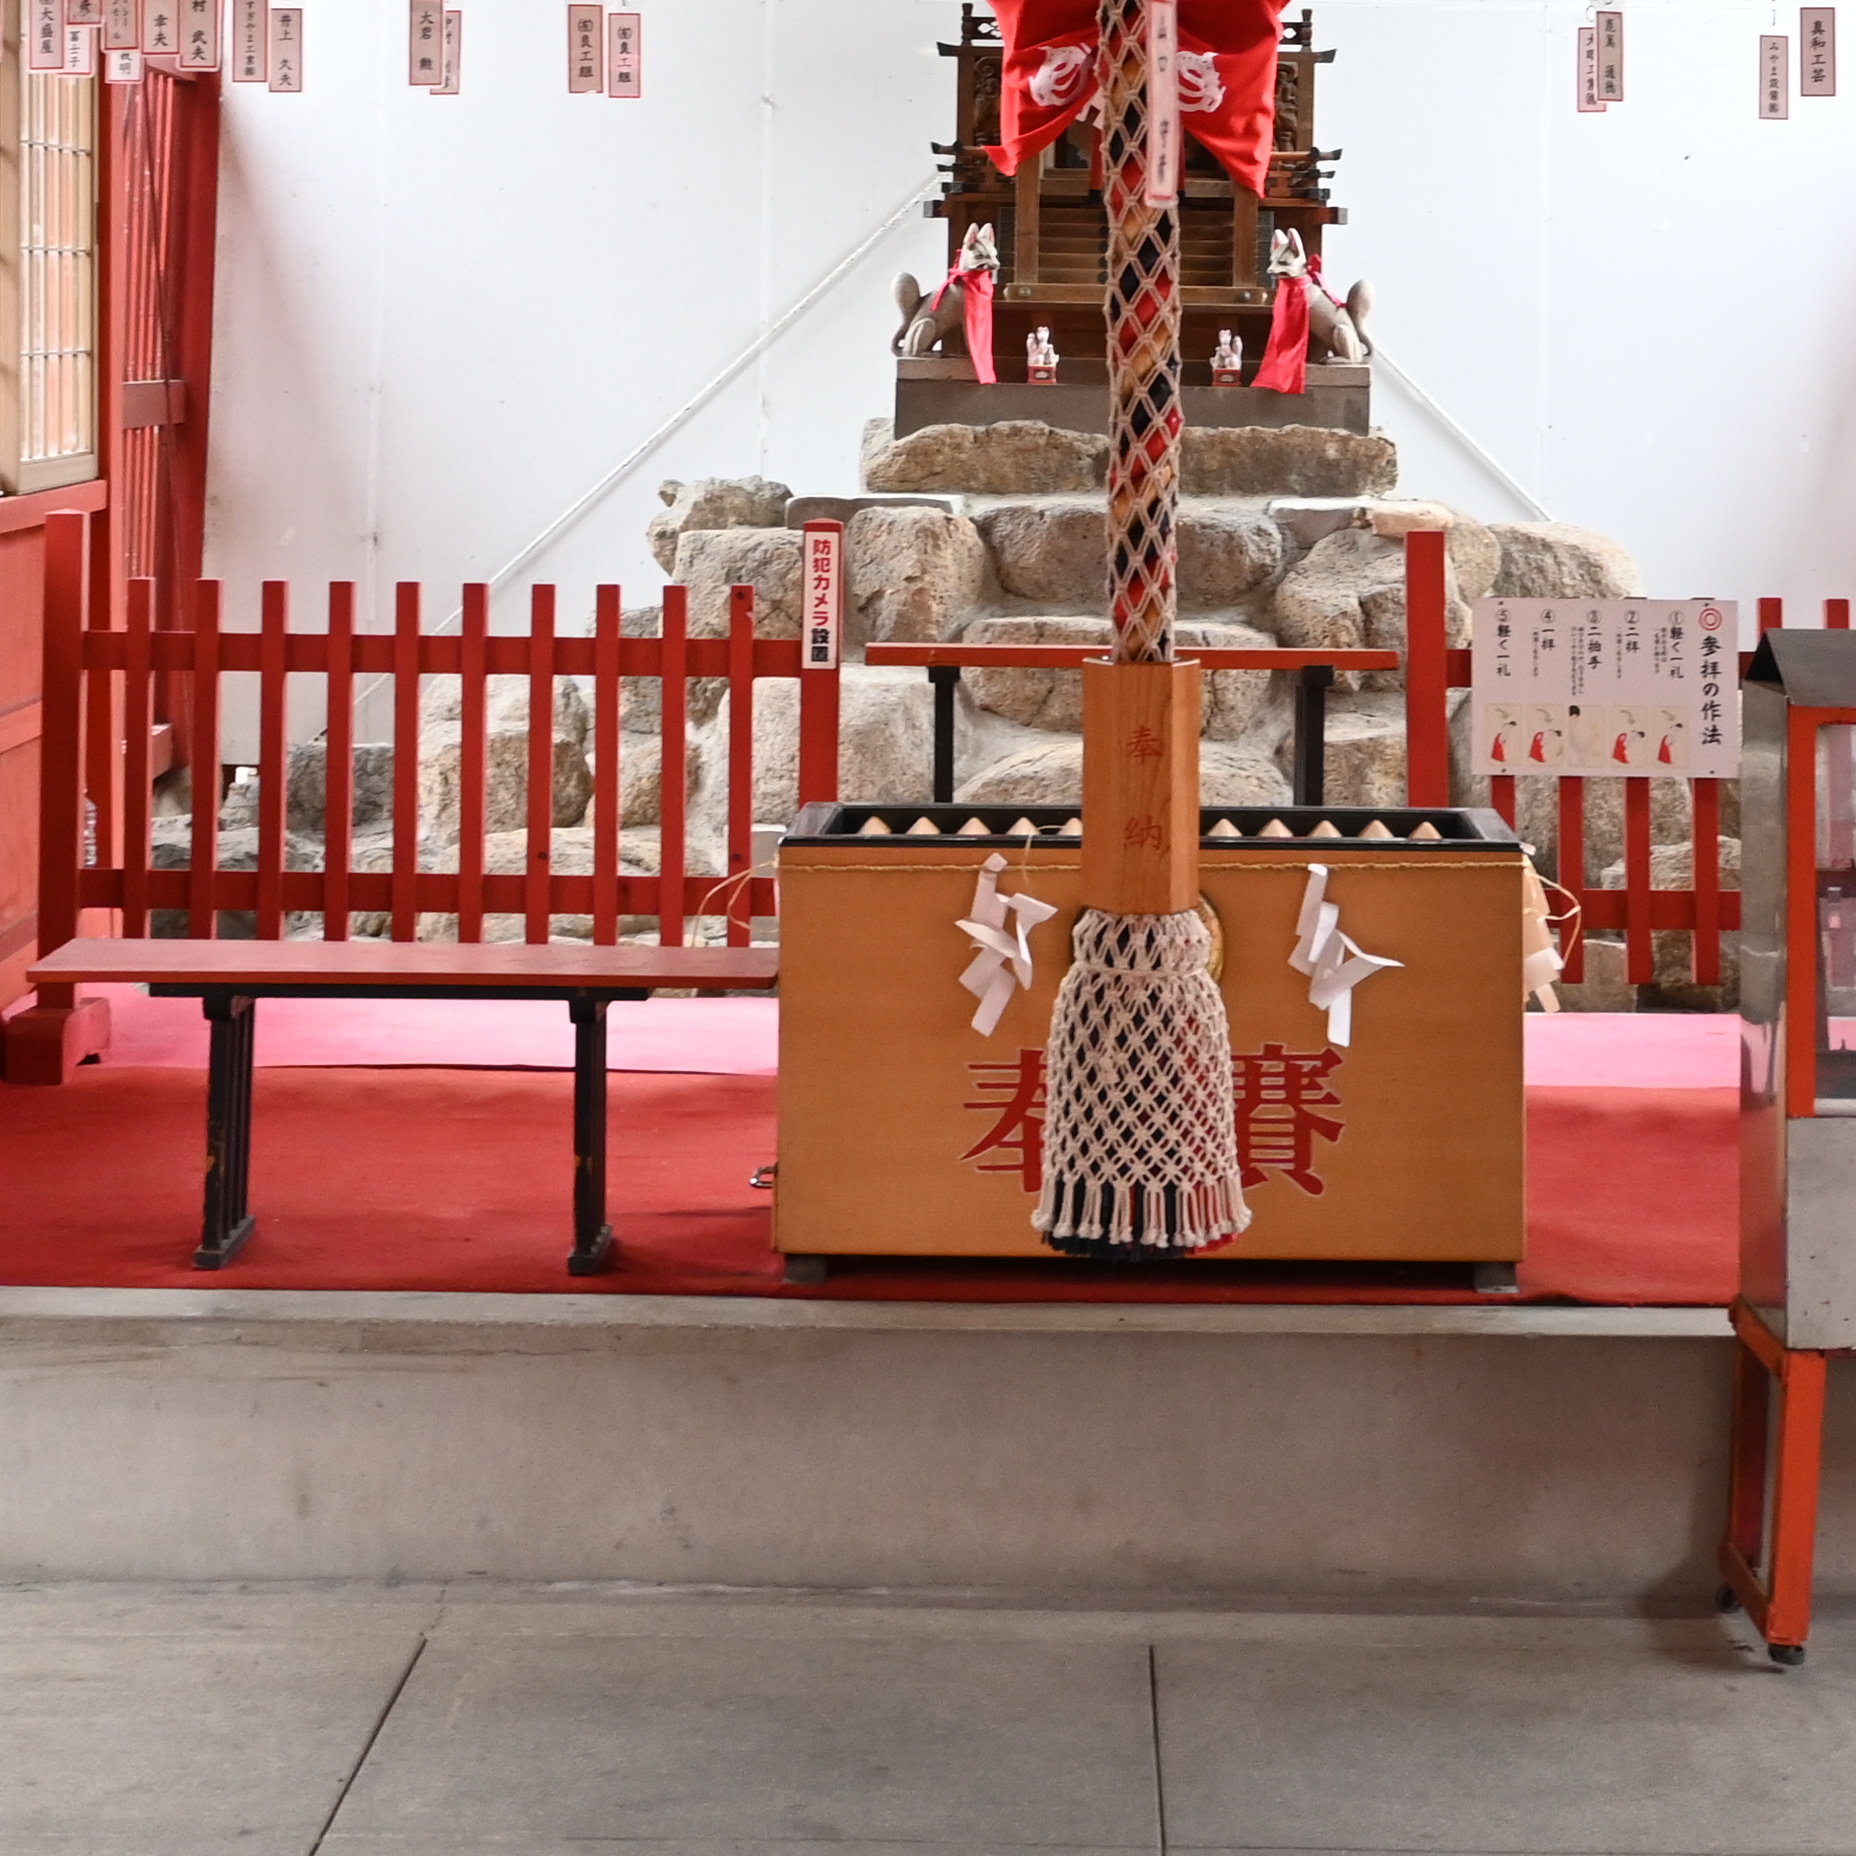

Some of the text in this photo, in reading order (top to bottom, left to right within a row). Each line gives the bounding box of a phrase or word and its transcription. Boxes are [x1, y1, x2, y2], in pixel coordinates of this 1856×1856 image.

[812, 538, 832, 663] 防犯カメラ設置
[1700, 635, 1723, 746] 参拝の作法
